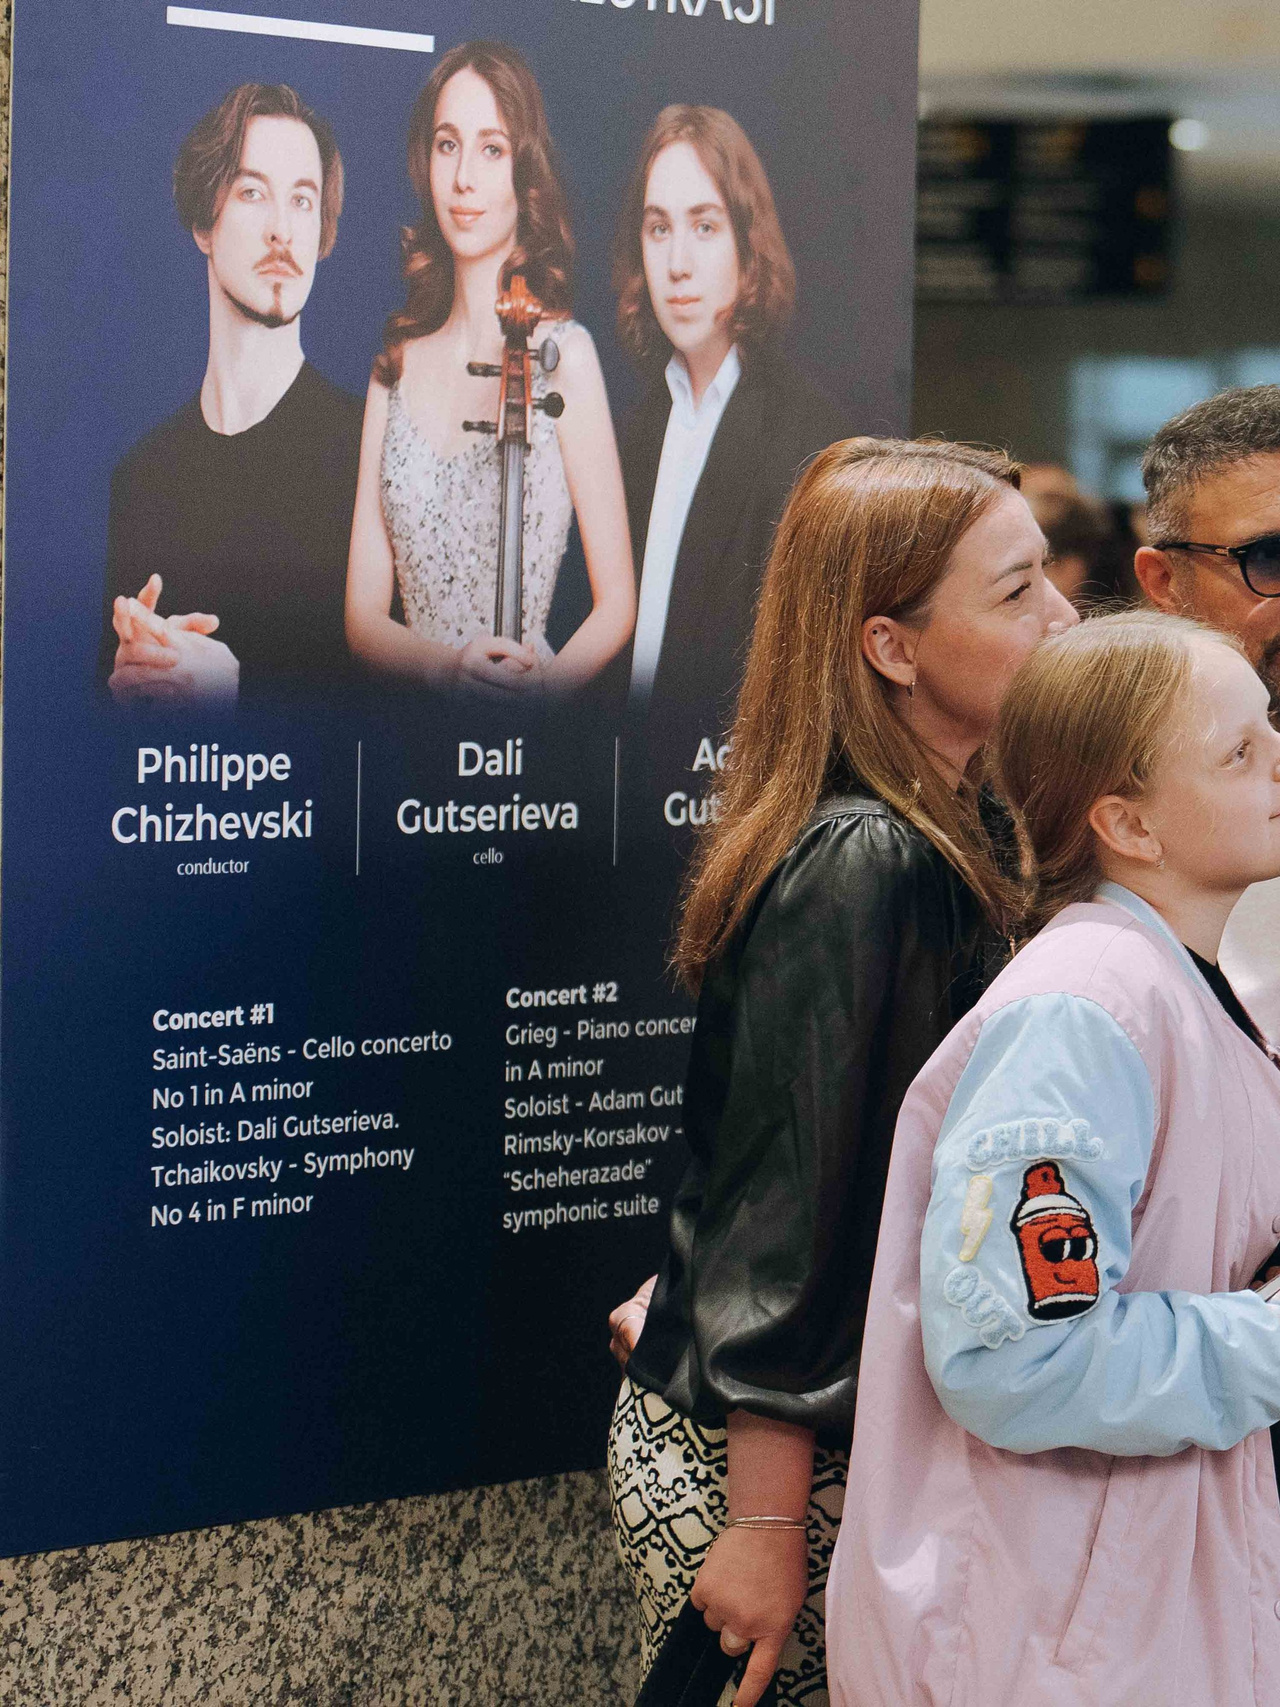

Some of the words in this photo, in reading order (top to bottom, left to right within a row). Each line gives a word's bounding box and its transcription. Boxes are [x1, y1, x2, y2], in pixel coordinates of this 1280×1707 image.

[137, 742, 292, 792] Philippe
[458, 737, 523, 777] Dali
[111, 798, 313, 844] Chizhevski
[396, 793, 579, 835] Gutserieva
[176, 857, 250, 876] conductor
[472, 847, 504, 865] cello
[505, 984, 587, 1009] Concert
[591, 981, 618, 1003] #2
[152, 1005, 245, 1032] Concert
[249, 1002, 274, 1025] #1
[505, 1022, 557, 1049] Grieg
[577, 1017, 630, 1041] Piano
[152, 1042, 281, 1071] Saint-Saëns
[302, 1035, 356, 1060] Cello
[360, 1030, 452, 1056] concerto
[505, 1060, 522, 1083] in
[527, 1059, 543, 1081] A
[547, 1055, 604, 1079] minor
[152, 1087, 185, 1110] No
[190, 1085, 198, 1107] 1
[204, 1082, 224, 1106] in
[229, 1081, 247, 1104] A
[251, 1077, 314, 1102] minor
[504, 1093, 570, 1119] Soloist
[588, 1088, 645, 1112] Adam
[649, 1084, 684, 1107] Gut
[151, 1121, 231, 1149] Soloist:
[237, 1115, 277, 1142] Dali
[283, 1109, 400, 1138] Gutserieva.
[504, 1122, 670, 1156] Rimsky-Korsakov
[966, 1117, 1105, 1172] CHILL
[150, 1155, 283, 1188] Tchaikovsky
[303, 1146, 415, 1179] Symphony
[151, 1204, 183, 1227] No
[188, 1201, 202, 1223] 4
[207, 1198, 226, 1222] in
[233, 1196, 246, 1219] F
[251, 1192, 314, 1218] minor
[502, 1197, 608, 1234] symphonic
[613, 1193, 660, 1218] suite
